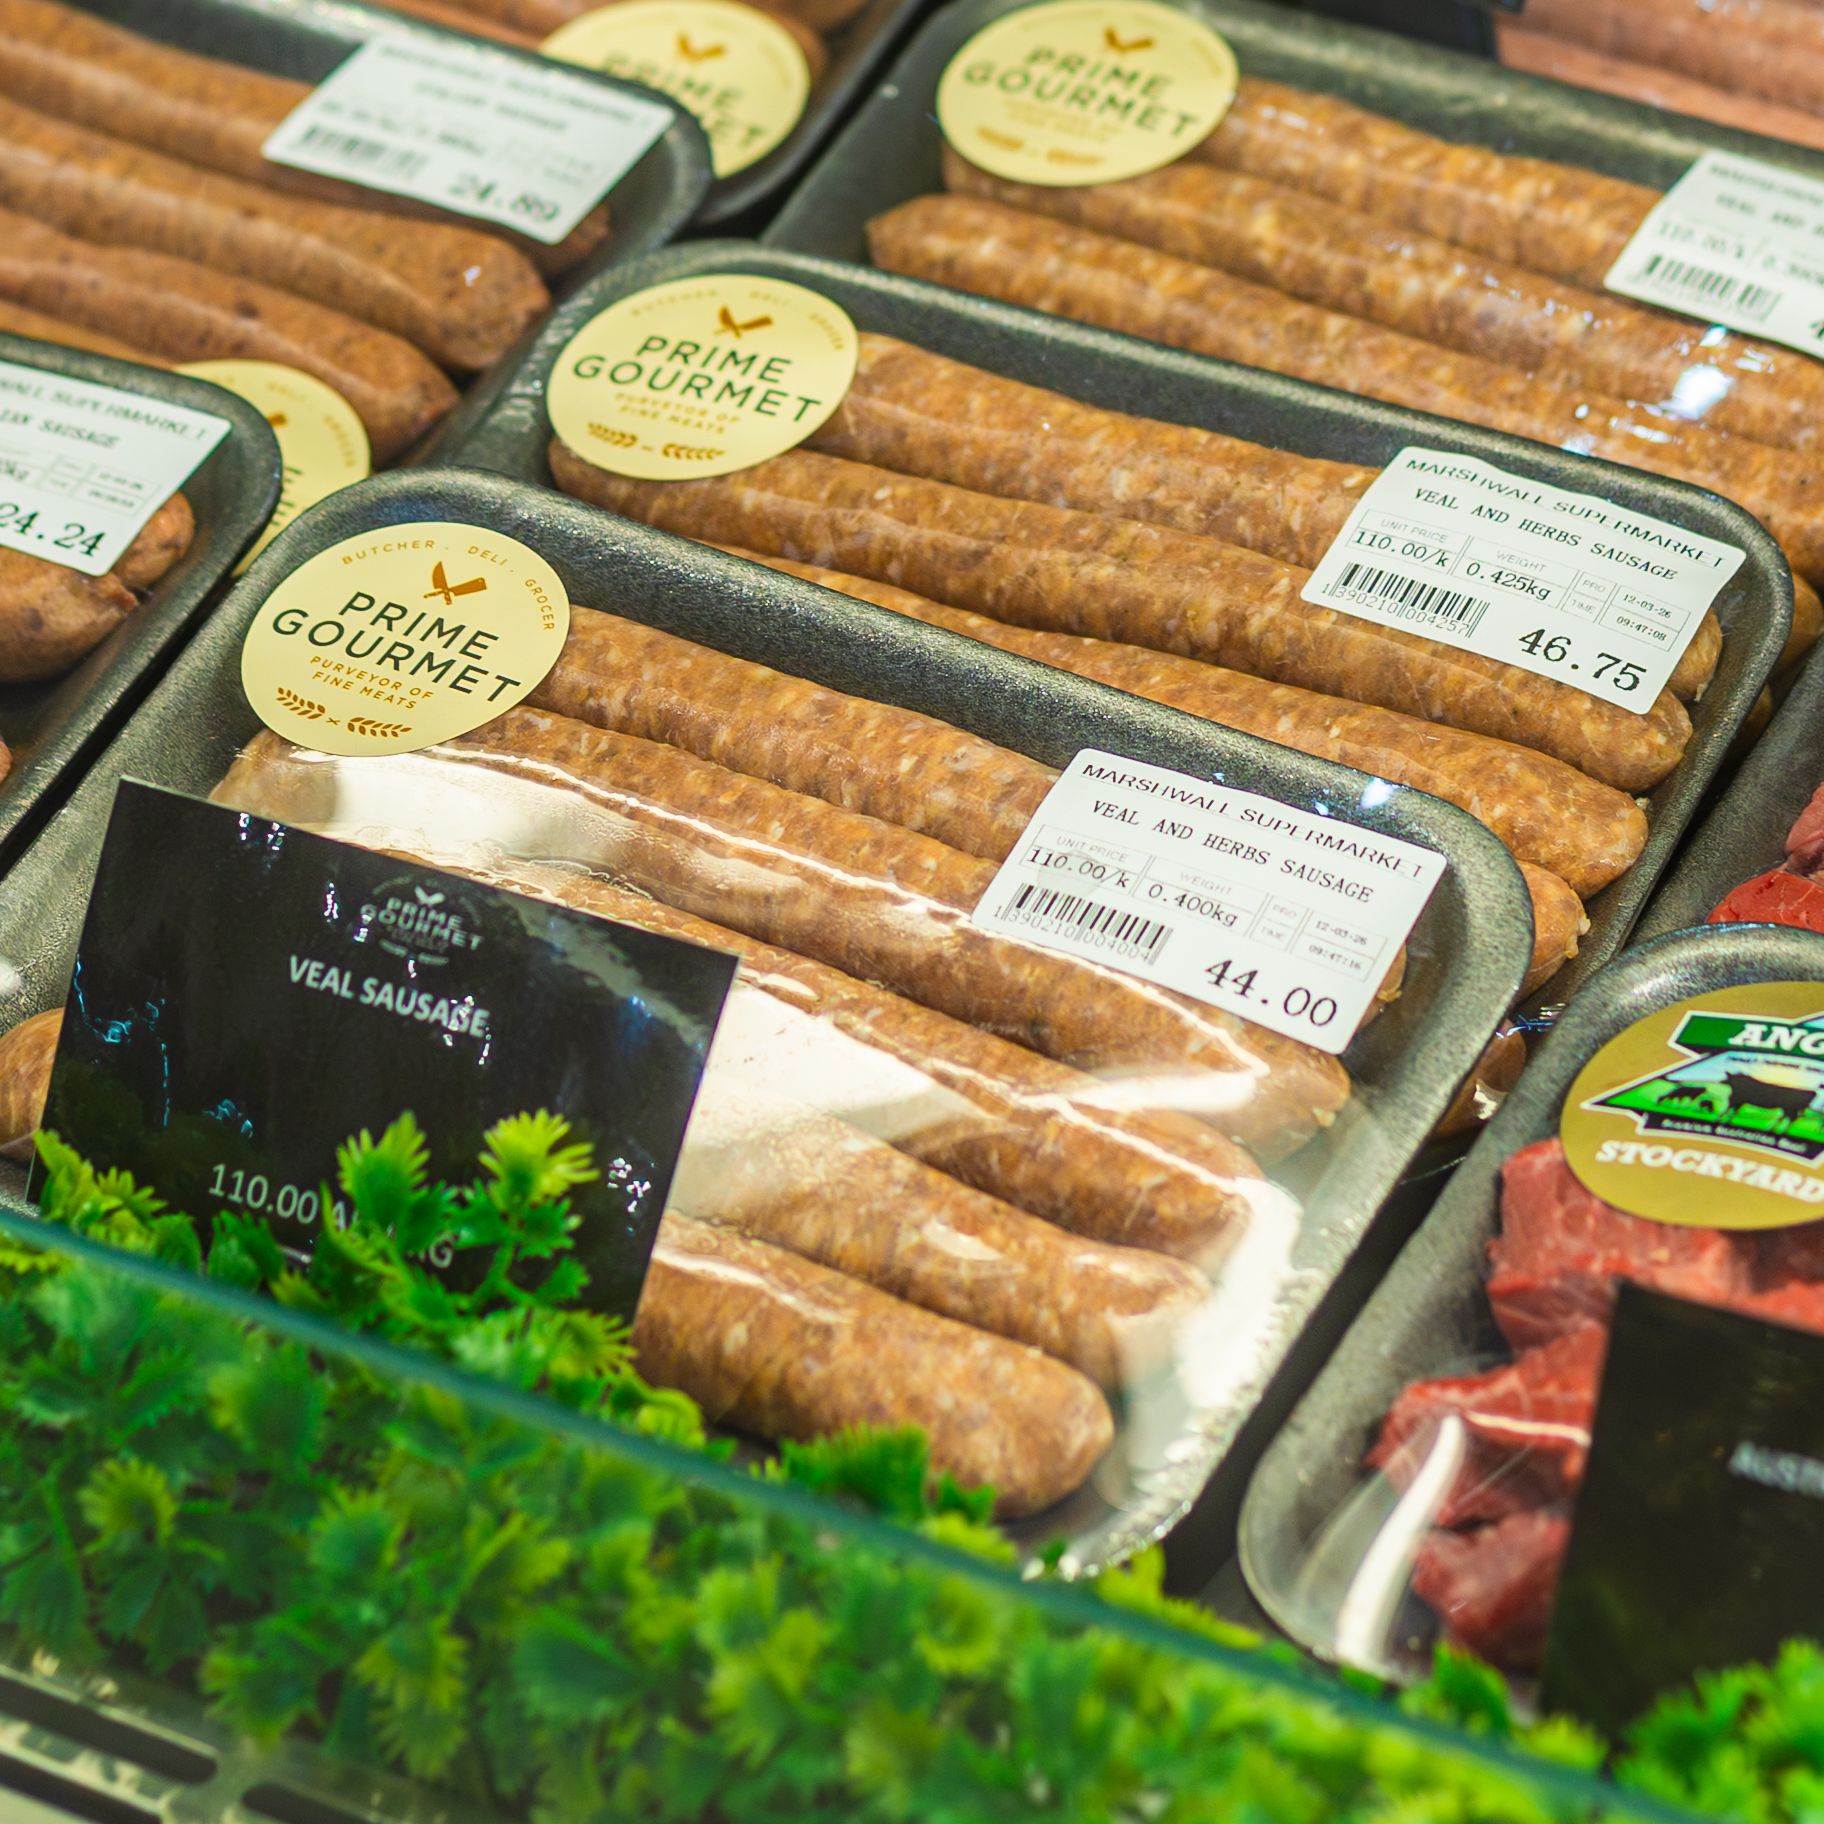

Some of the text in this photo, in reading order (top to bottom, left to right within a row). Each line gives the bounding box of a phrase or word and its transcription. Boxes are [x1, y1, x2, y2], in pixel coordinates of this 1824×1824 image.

[636, 335, 792, 384] PRIME
[573, 355, 822, 423] GOURMET
[1380, 519, 1449, 544] UNIT PRICE
[1406, 459, 1723, 568] MARSHWALL SUPERMARKET
[1415, 488, 1678, 581] VEAL AND HERBS SAUSAGE
[342, 540, 435, 565] BUTCHER
[467, 545, 507, 566] DELI
[1352, 531, 1449, 568] 110.00/k
[1497, 551, 1546, 573] WEIGHT
[524, 579, 555, 631] GROCER
[1466, 562, 1552, 601] 0.425kg
[1623, 594, 1672, 619] 12-03-26
[338, 591, 500, 660] PRIME
[272, 608, 522, 703] GOURMET
[310, 656, 434, 701] PURVEYOR OF
[1518, 628, 1647, 691] 46.75
[312, 672, 418, 710] FINE MEATS
[1082, 764, 1424, 879] MARSHWALL SUPERMARKET
[1027, 848, 1130, 888] 110.00/k
[1093, 800, 1375, 904] VEAL AND HERBS SAUSAGE
[1148, 884, 1238, 928] 0.400kg
[287, 956, 489, 1037] VEAL SAUSAGE
[1204, 958, 1338, 1027] 44.00
[209, 1164, 318, 1224] 110.00
